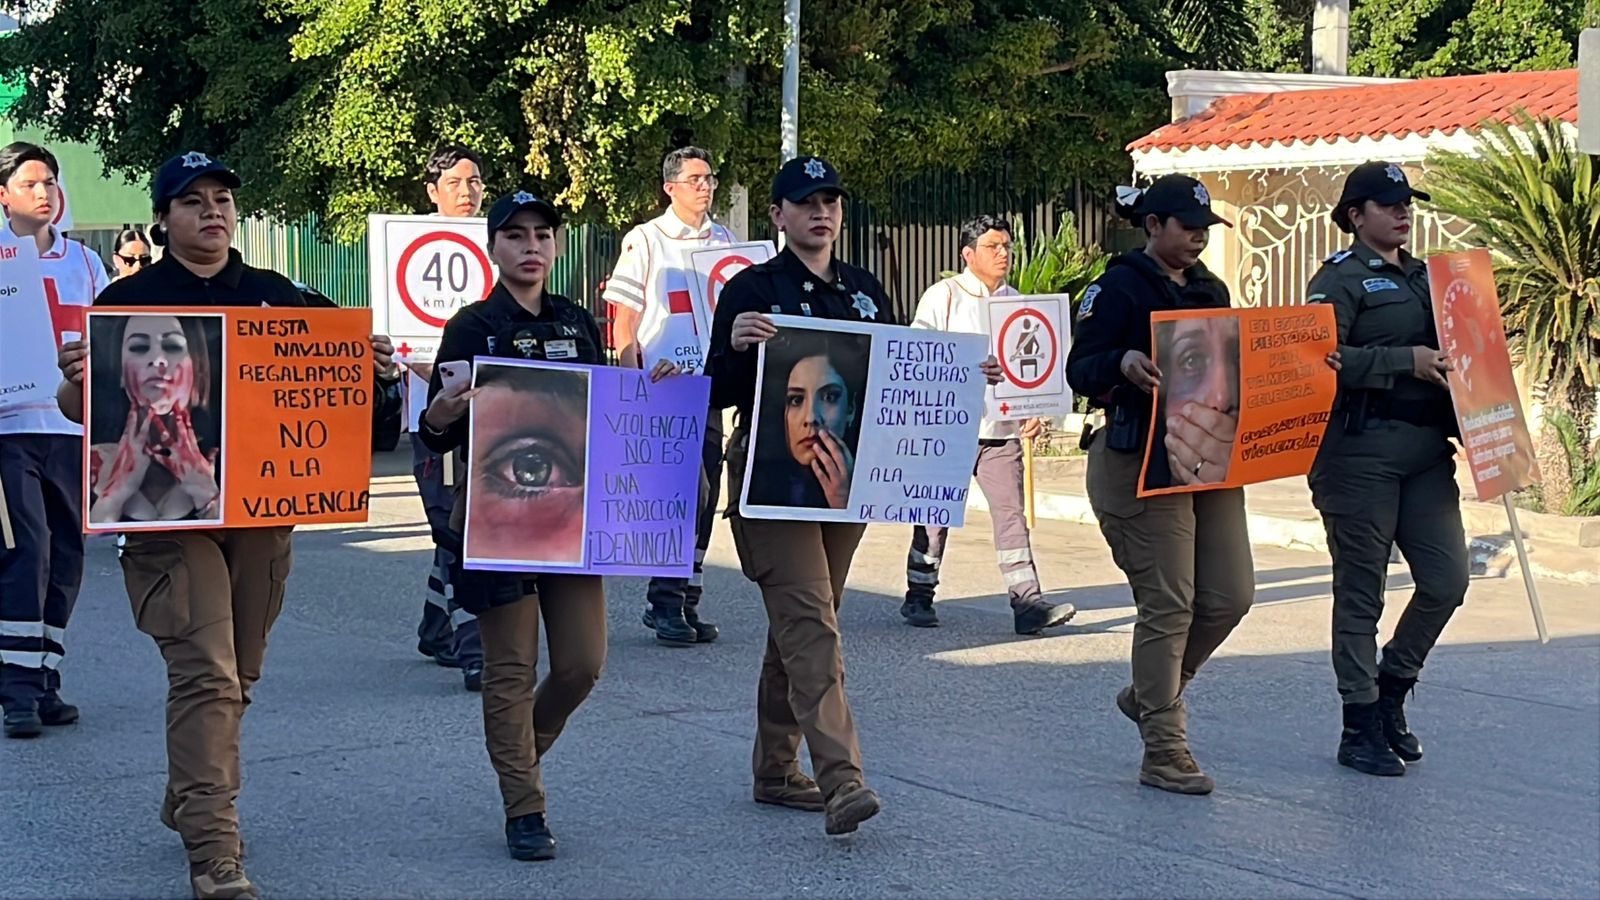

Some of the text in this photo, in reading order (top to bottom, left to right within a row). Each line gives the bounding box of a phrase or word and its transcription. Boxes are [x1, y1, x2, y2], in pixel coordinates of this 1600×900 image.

[0, 246, 17, 259] lar
[422, 252, 468, 292] 40
[0, 284, 18, 296] ojo
[267, 319, 309, 337] ESTA
[274, 341, 365, 358] NAVIDAD
[675, 346, 699, 357] CRU
[887, 340, 956, 364] FIESTAS
[240, 364, 362, 383] REGALAMOS
[677, 359, 703, 369] MEX
[890, 361, 970, 383] SEGURAS
[273, 387, 367, 409] RESPETO
[620, 373, 648, 402] LA
[881, 388, 955, 407] FAMILIA
[877, 407, 969, 426] SIN MIEDO
[280, 420, 327, 449] NO
[604, 413, 699, 442] VIOLENCIA
[625, 438, 684, 465] NO ES
[896, 438, 945, 456] ALTO
[261, 457, 320, 478] A LA
[605, 472, 640, 496] UNA
[903, 484, 968, 501] VIOLENCIA
[242, 490, 370, 518] VIOLENCIA
[601, 492, 687, 523] TRADICIÓN
[860, 504, 876, 520] DE
[587, 525, 684, 570] ¡DENUNCIA!
